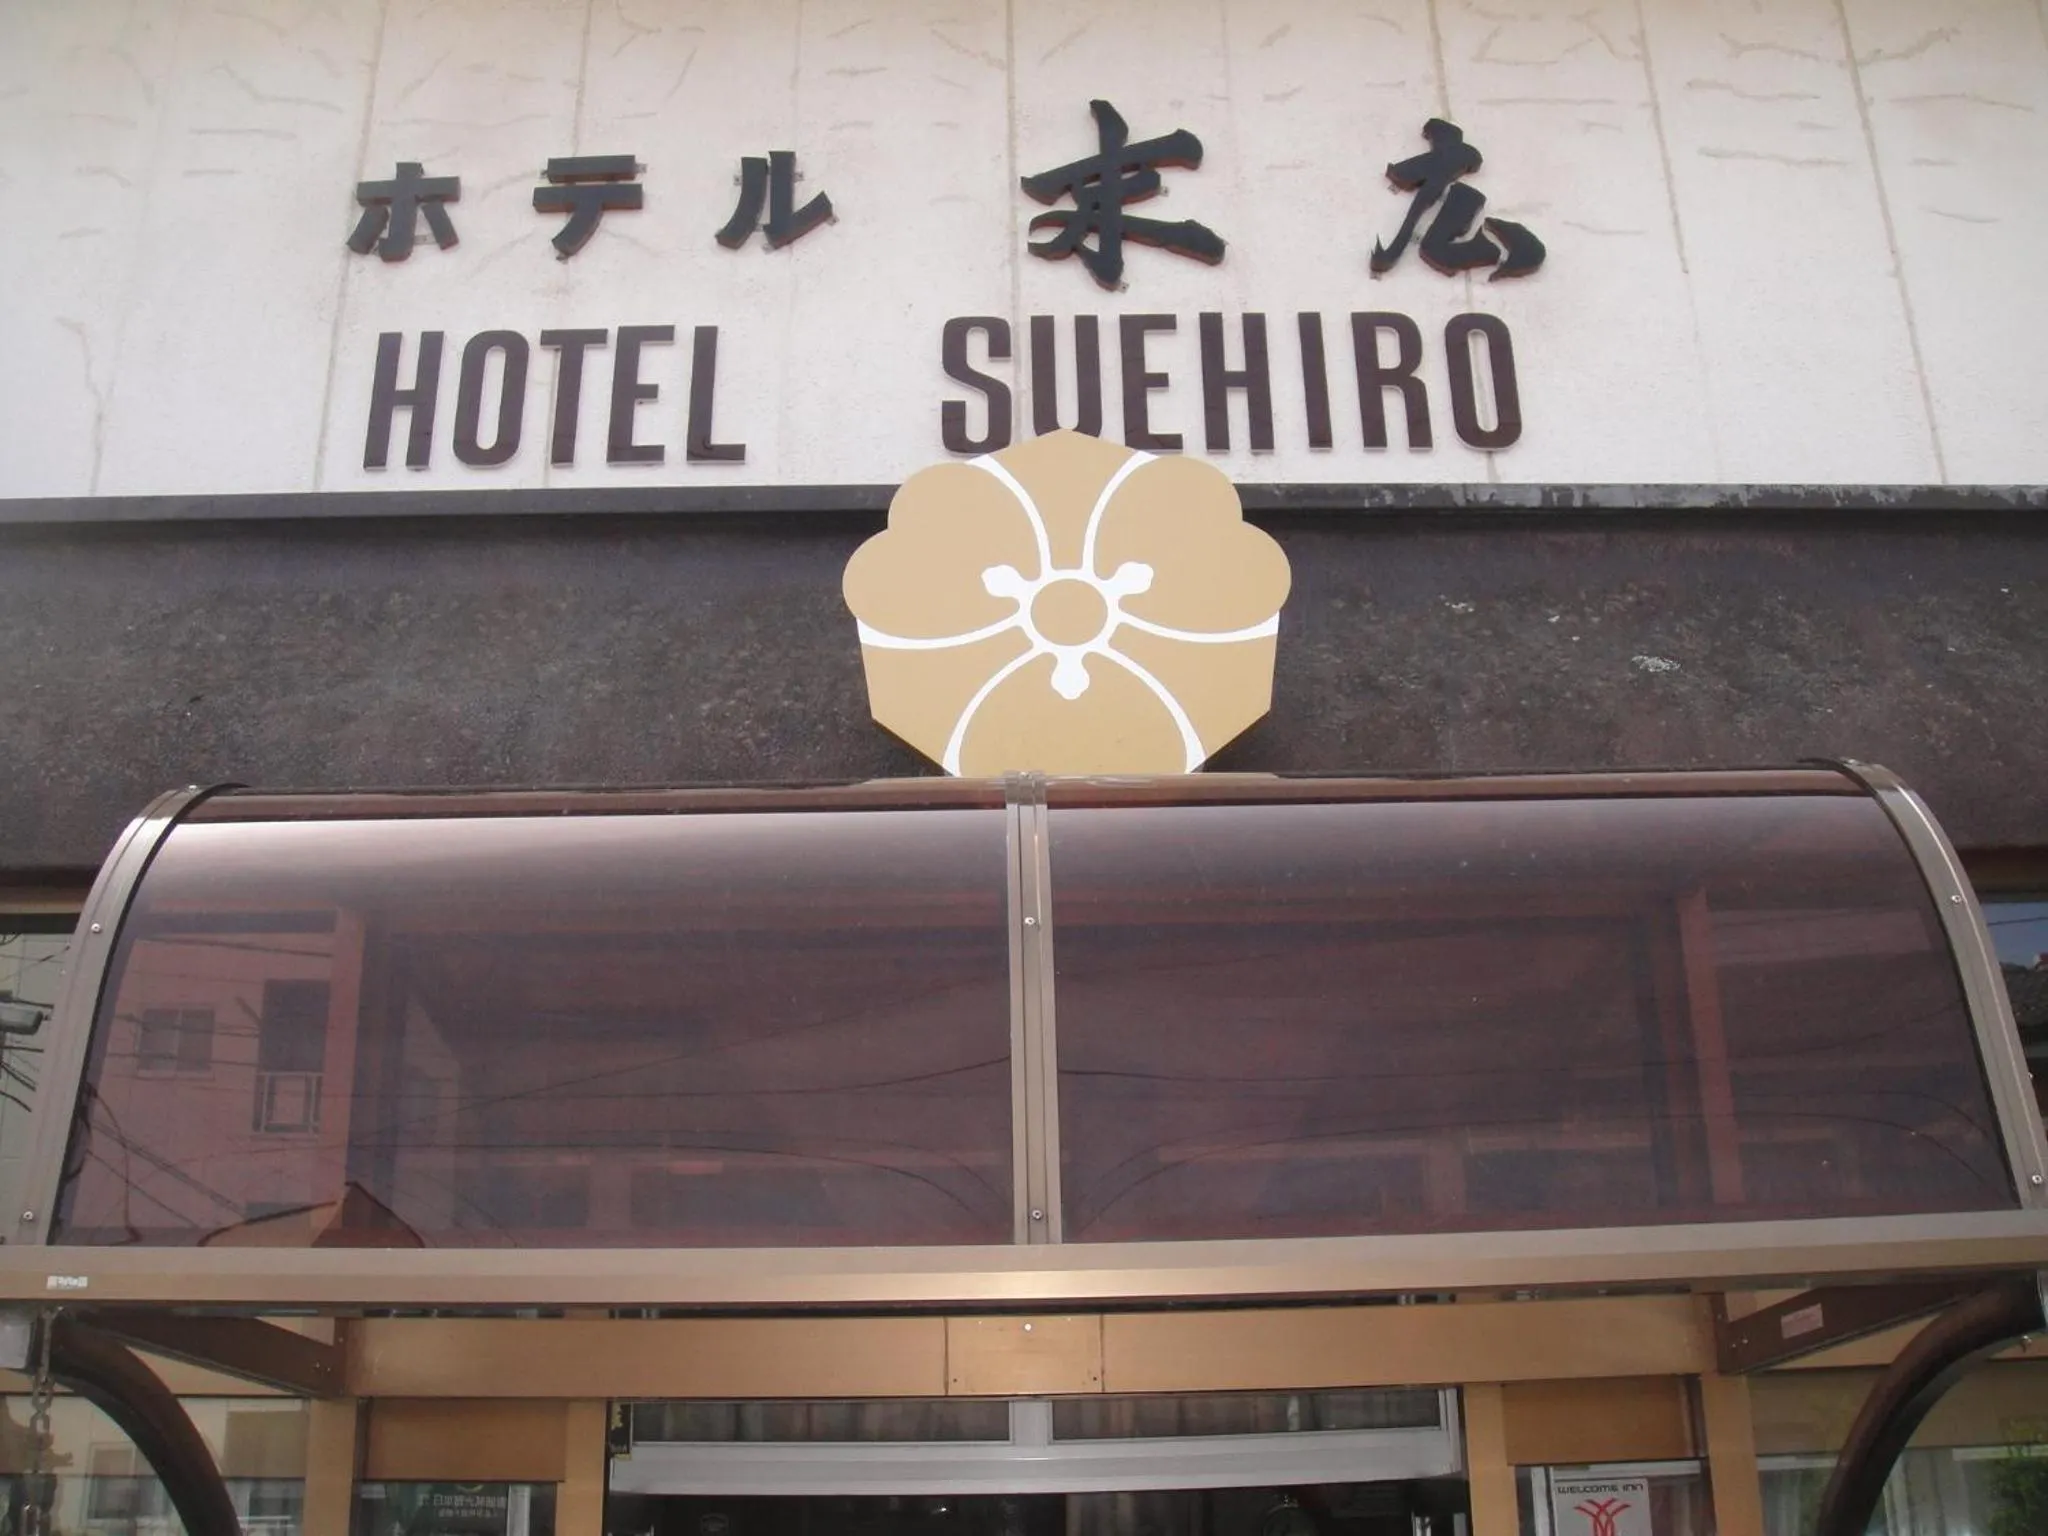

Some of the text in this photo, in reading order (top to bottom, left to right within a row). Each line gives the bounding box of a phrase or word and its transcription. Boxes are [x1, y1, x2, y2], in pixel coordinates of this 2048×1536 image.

[347, 150, 833, 263] ホテル
[363, 311, 1523, 470] HOTEL SUEHIRO
